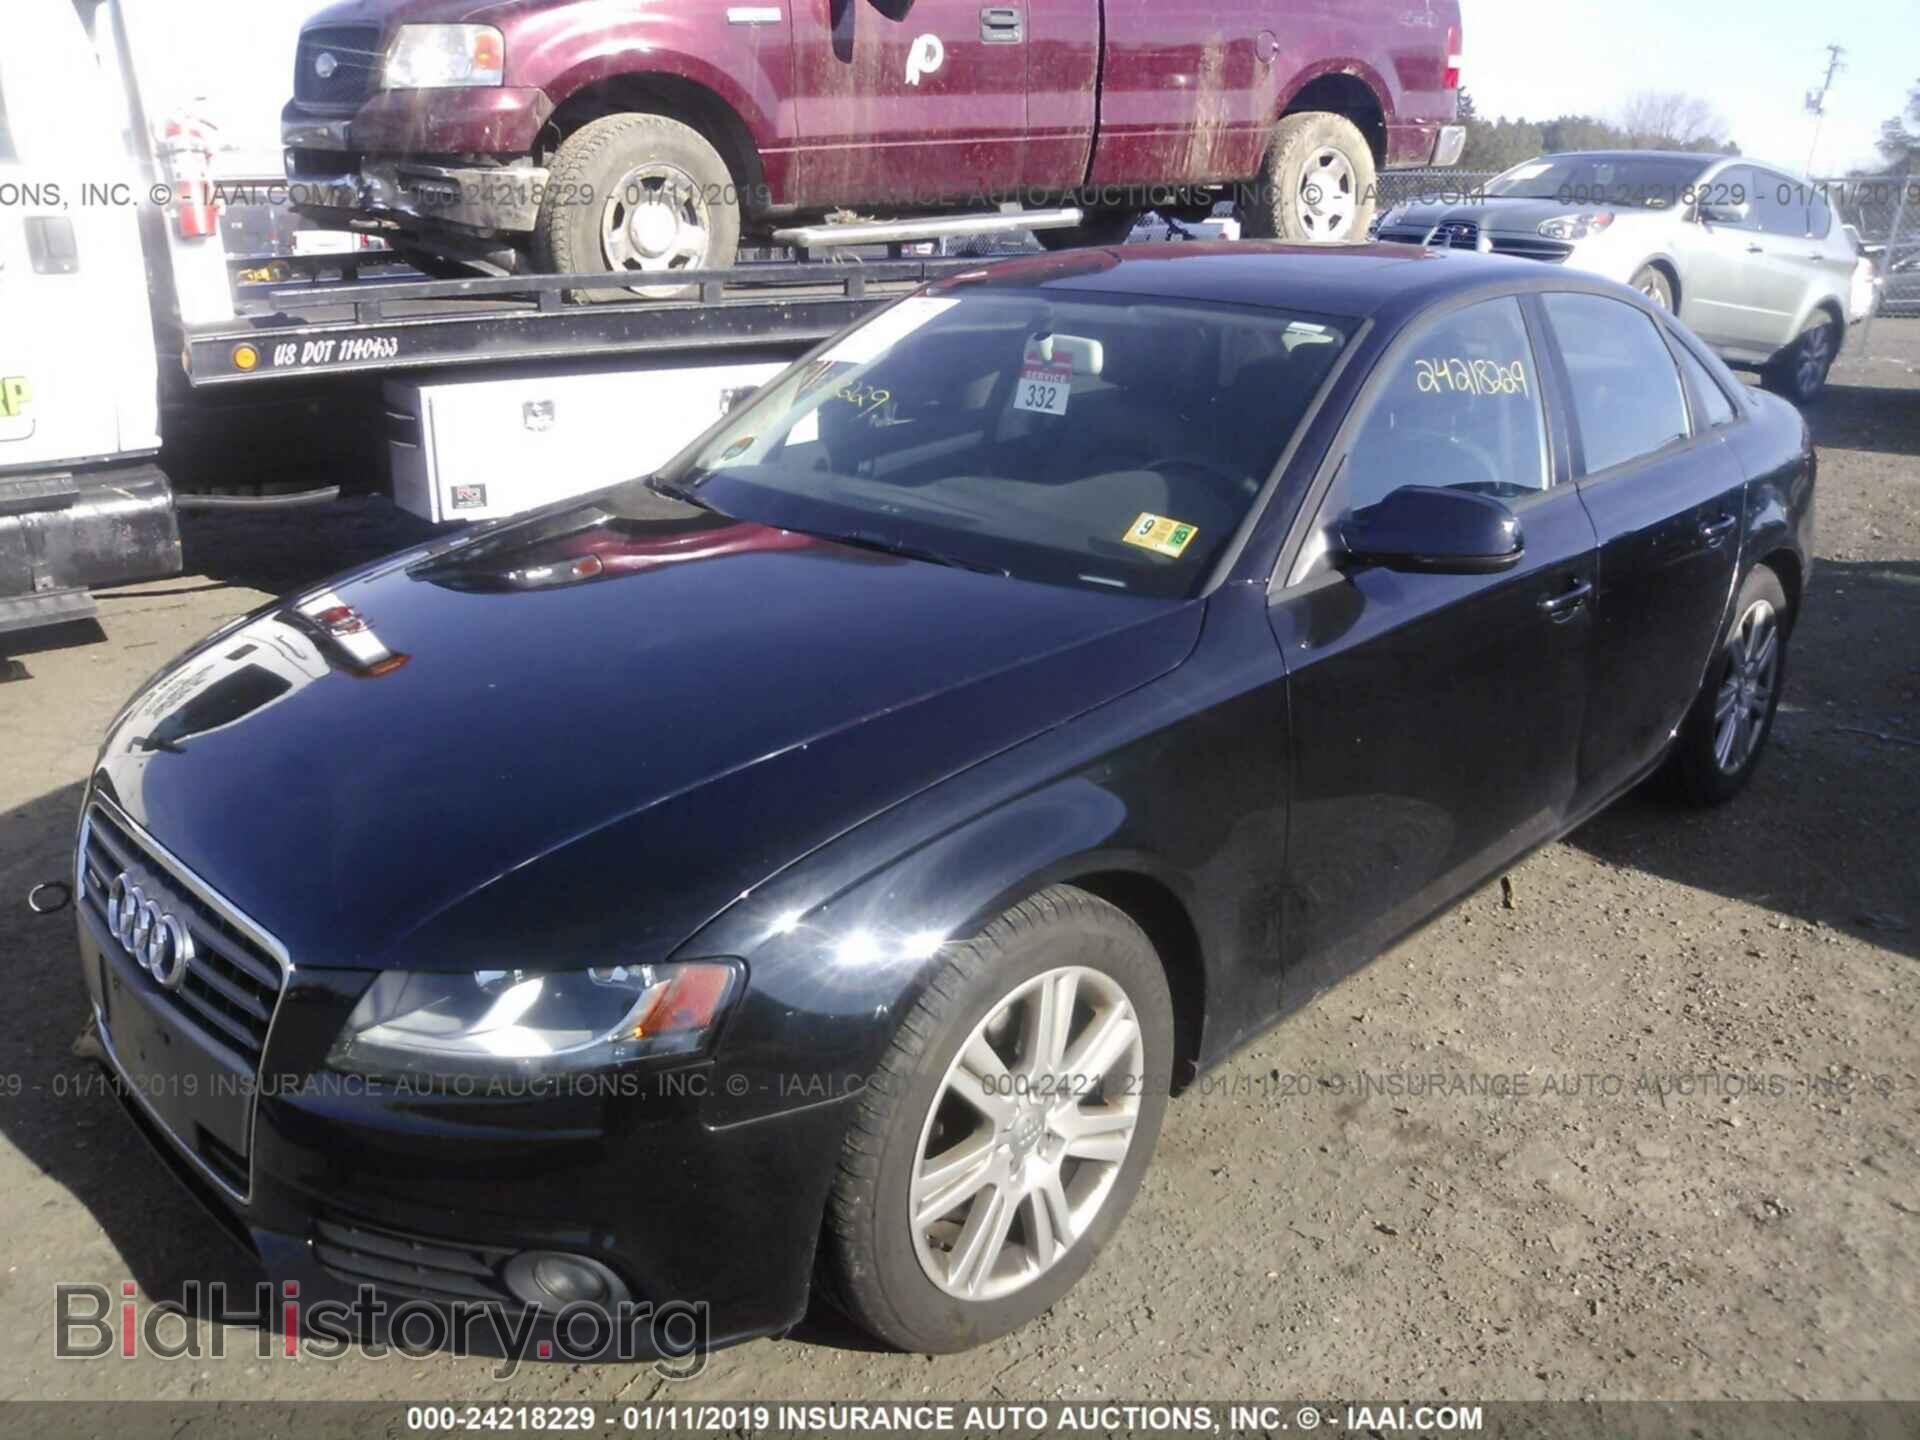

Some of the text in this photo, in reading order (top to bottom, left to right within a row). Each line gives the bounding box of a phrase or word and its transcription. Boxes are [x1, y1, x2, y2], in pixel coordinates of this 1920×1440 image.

[273, 343, 297, 366] US
[301, 340, 336, 364] DOT
[1025, 384, 1057, 409] 332
